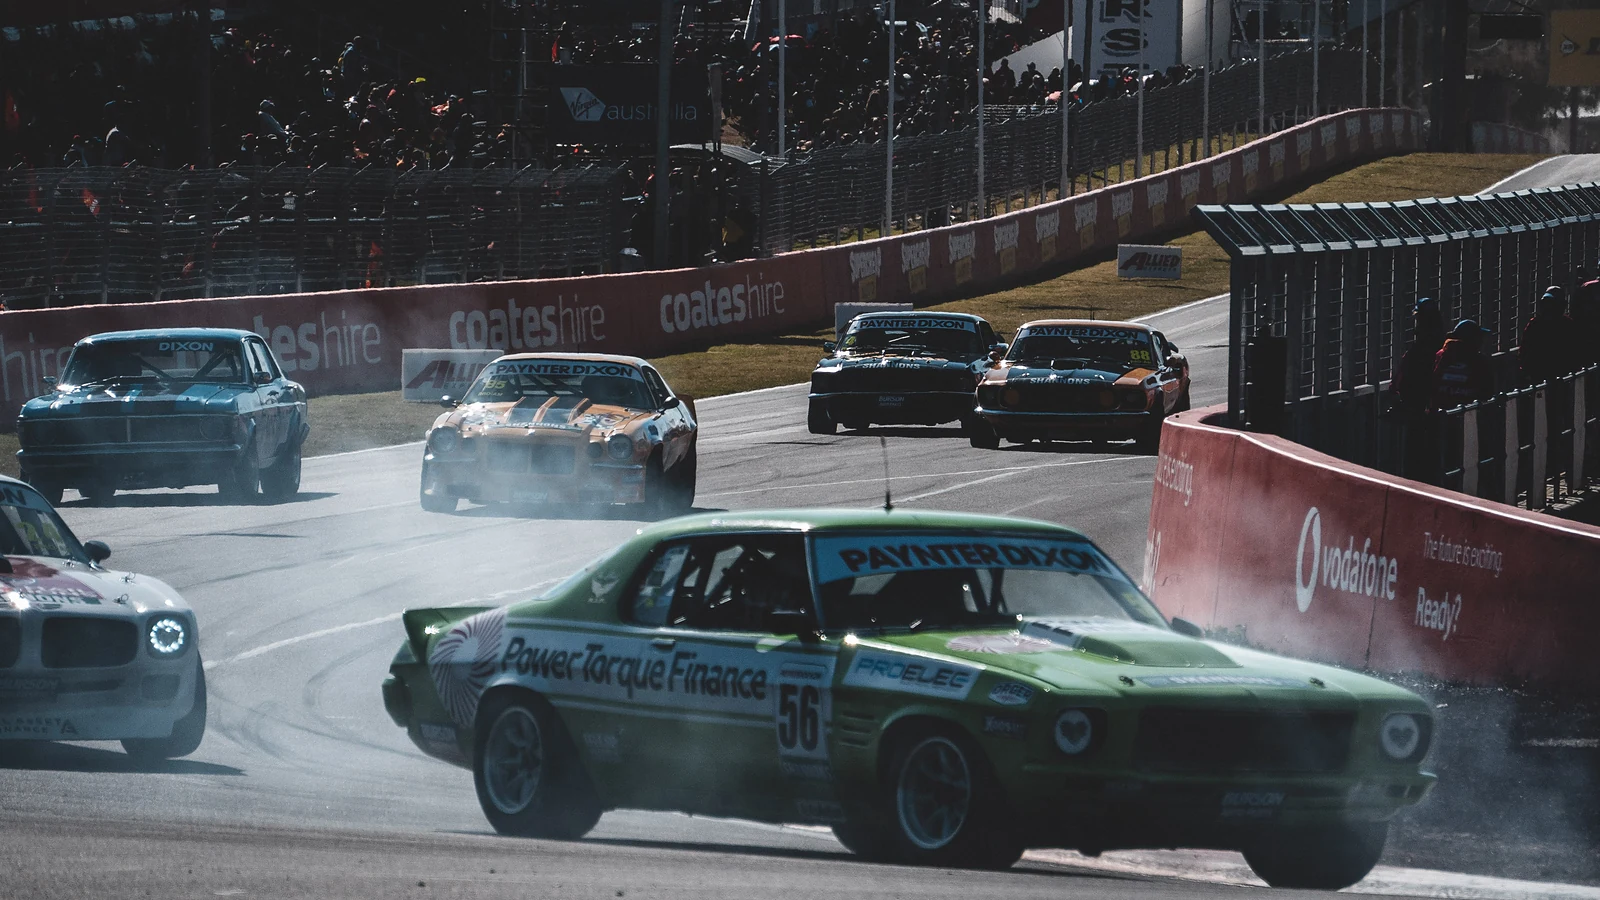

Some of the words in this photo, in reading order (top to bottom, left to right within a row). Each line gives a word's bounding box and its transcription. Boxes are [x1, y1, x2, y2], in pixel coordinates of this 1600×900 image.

[569, 92, 600, 119] Virgin
[607, 102, 697, 121] austlia
[1119, 252, 1181, 271] ALLIED
[159, 341, 214, 352] DIXON
[1130, 350, 1150, 361] 88
[1423, 531, 1438, 560] The
[1438, 534, 1462, 565] future
[1323, 535, 1398, 601] vodafone
[1414, 586, 1462, 641] Ready?
[779, 683, 819, 751] 56
